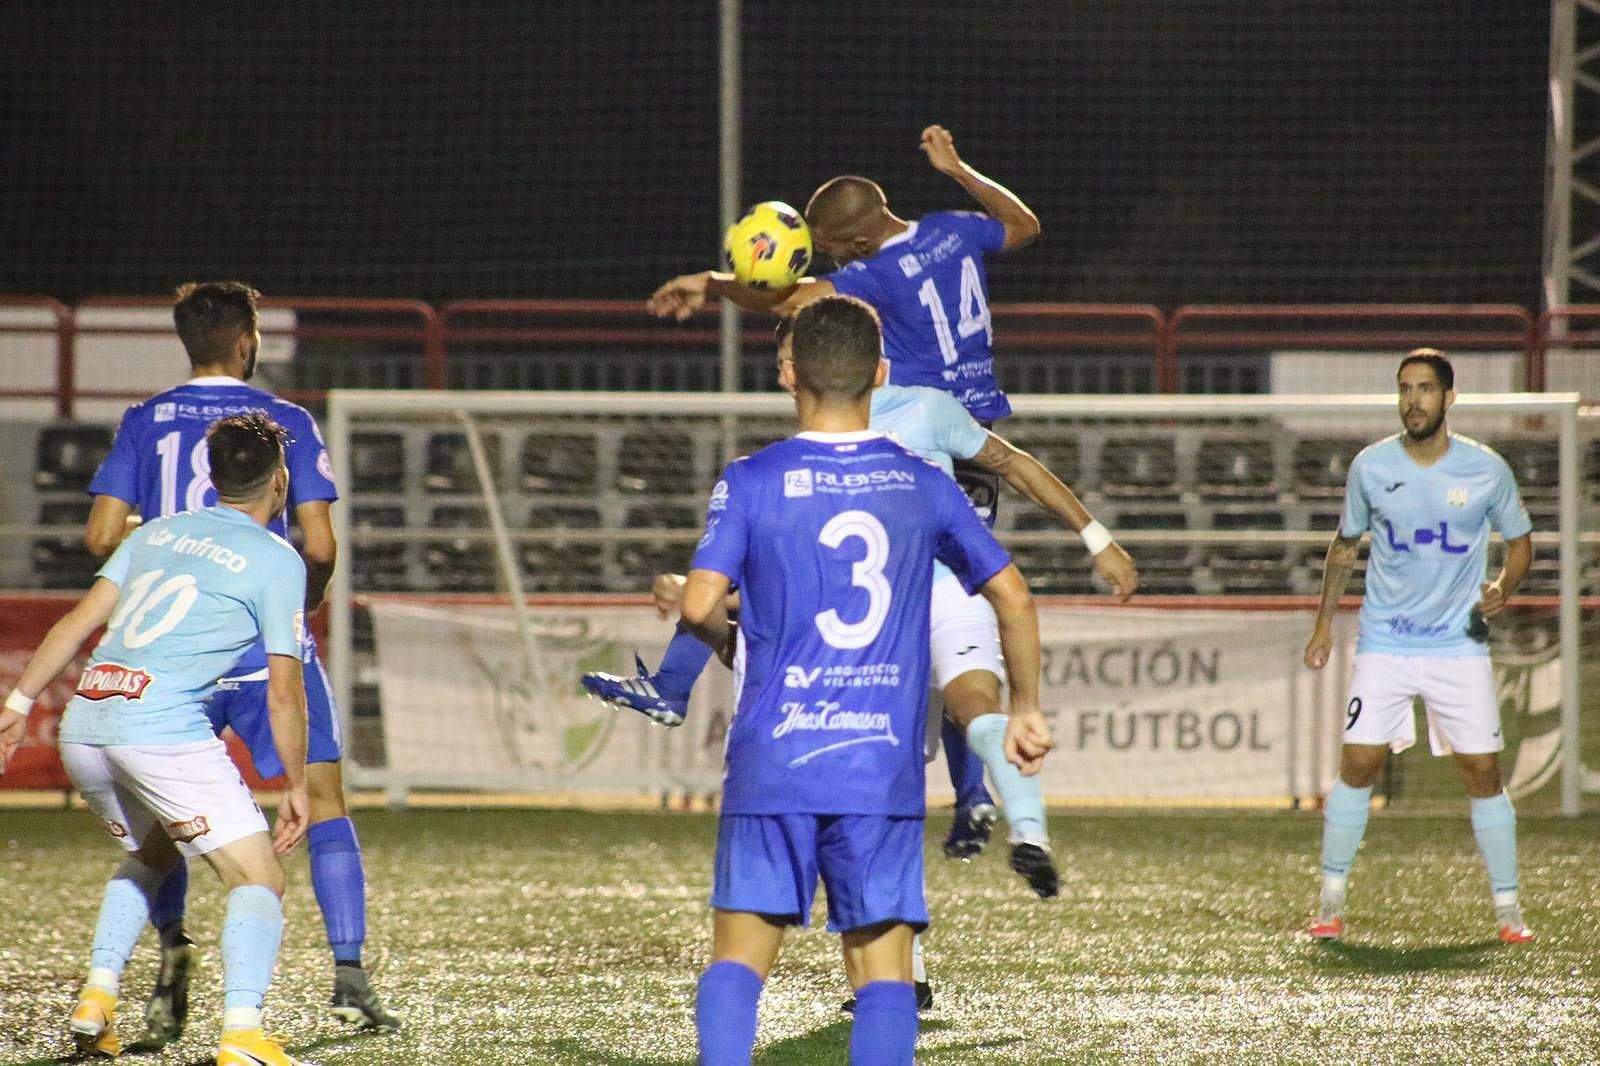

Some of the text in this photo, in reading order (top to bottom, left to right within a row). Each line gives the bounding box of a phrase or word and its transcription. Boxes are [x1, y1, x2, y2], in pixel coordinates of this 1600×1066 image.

[918, 255, 993, 366] 14
[156, 431, 219, 516] 18
[815, 470, 916, 487] RUBYSAN
[172, 534, 247, 573] Infrico
[815, 510, 892, 650] 3
[99, 568, 199, 649] 10
[1078, 703, 1270, 751] FÚTBOL
[1346, 697, 1362, 730] 9
